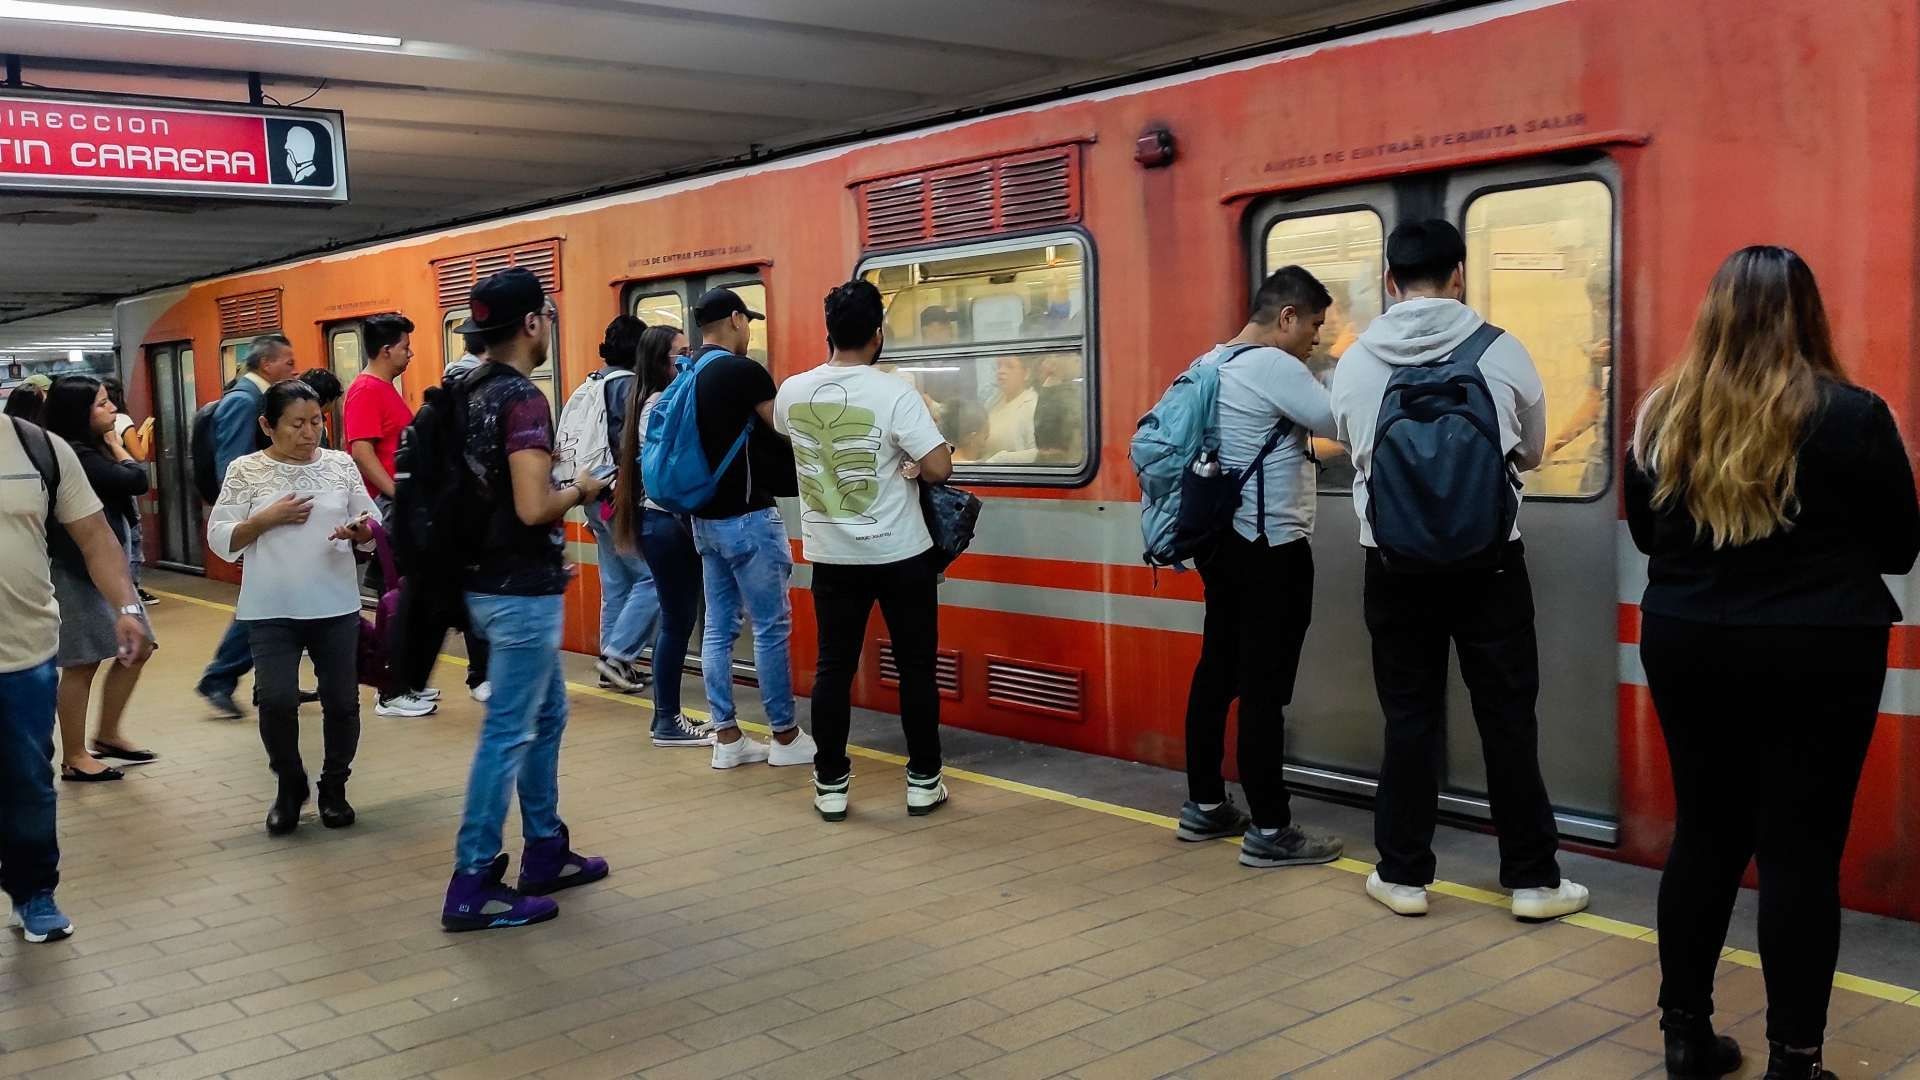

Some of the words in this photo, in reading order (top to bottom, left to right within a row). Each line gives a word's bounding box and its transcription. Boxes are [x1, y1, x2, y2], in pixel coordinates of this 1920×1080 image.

[0, 109, 168, 135] IRECCION
[70, 142, 255, 175] CARRERA
[1323, 151, 1345, 164] DE
